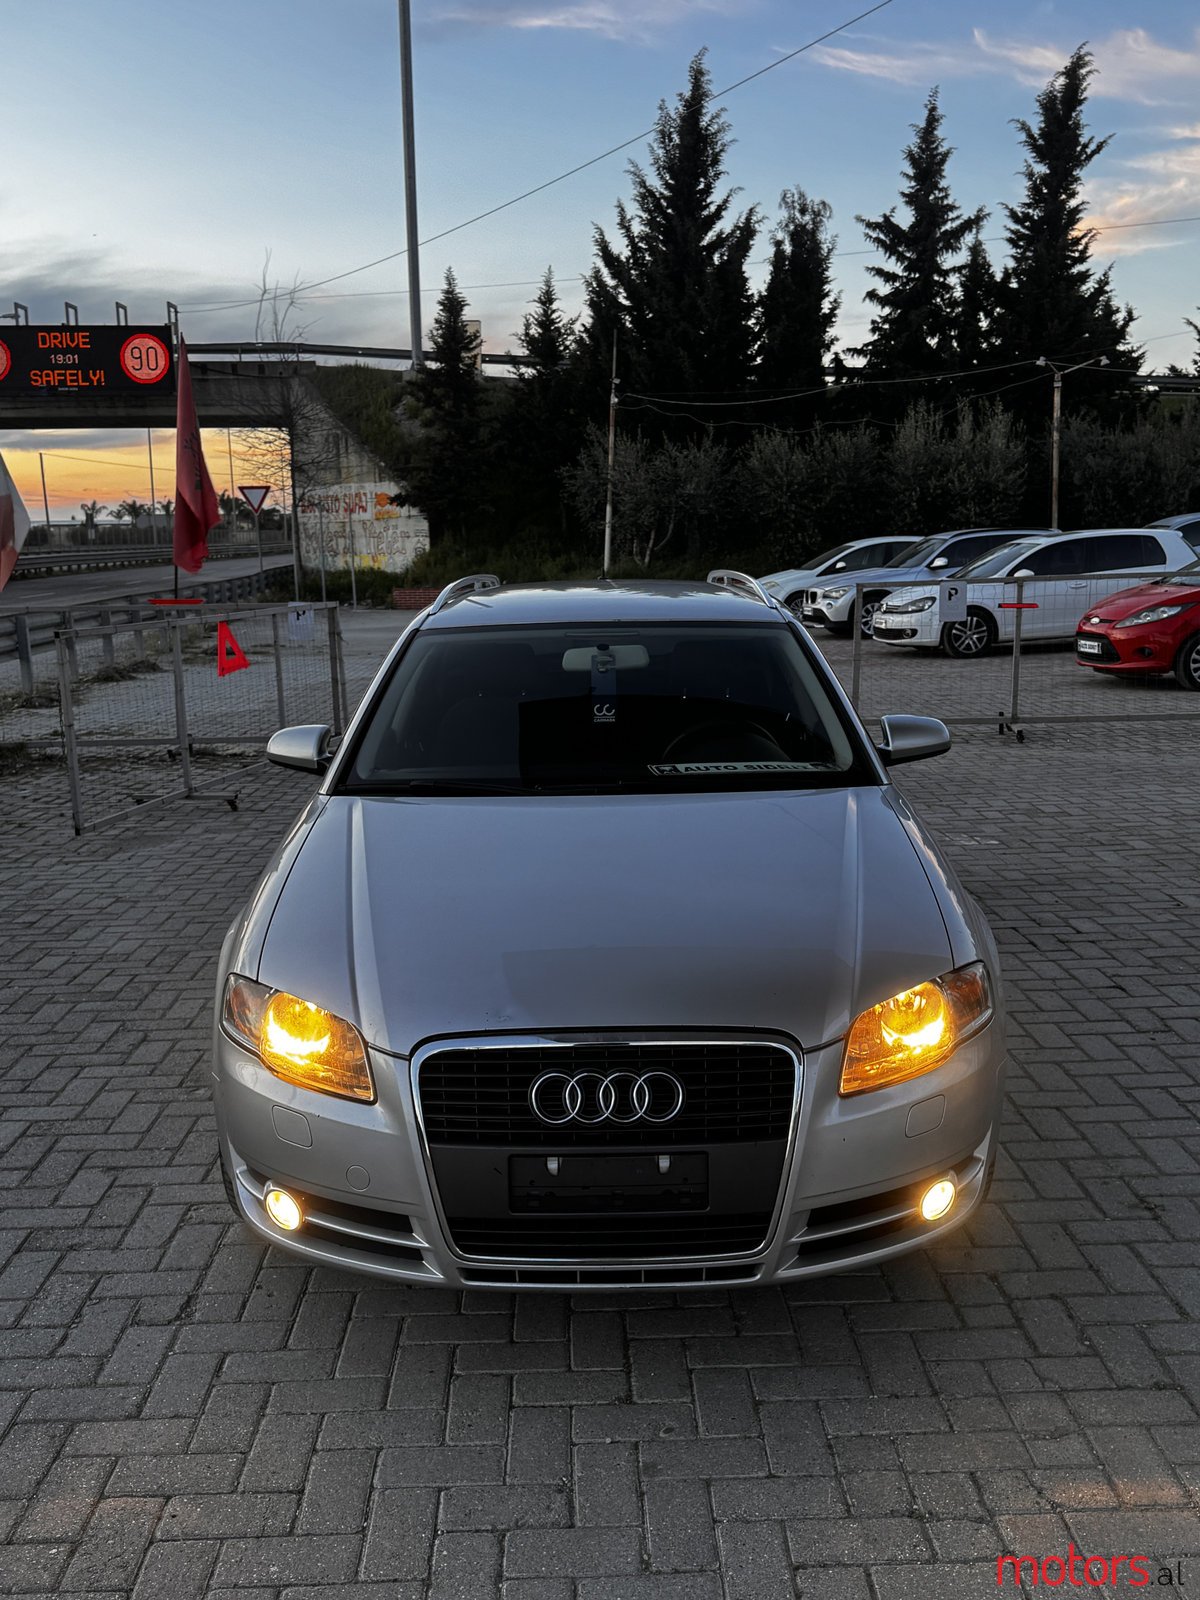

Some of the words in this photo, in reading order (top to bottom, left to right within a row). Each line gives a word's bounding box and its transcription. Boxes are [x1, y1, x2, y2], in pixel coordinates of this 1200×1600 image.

[38, 332, 91, 348] DRIVE
[50, 354, 79, 364] 19:01
[130, 346, 159, 371] 90
[30, 370, 105, 386] SAFELY!
[684, 765, 738, 773] AUTO
